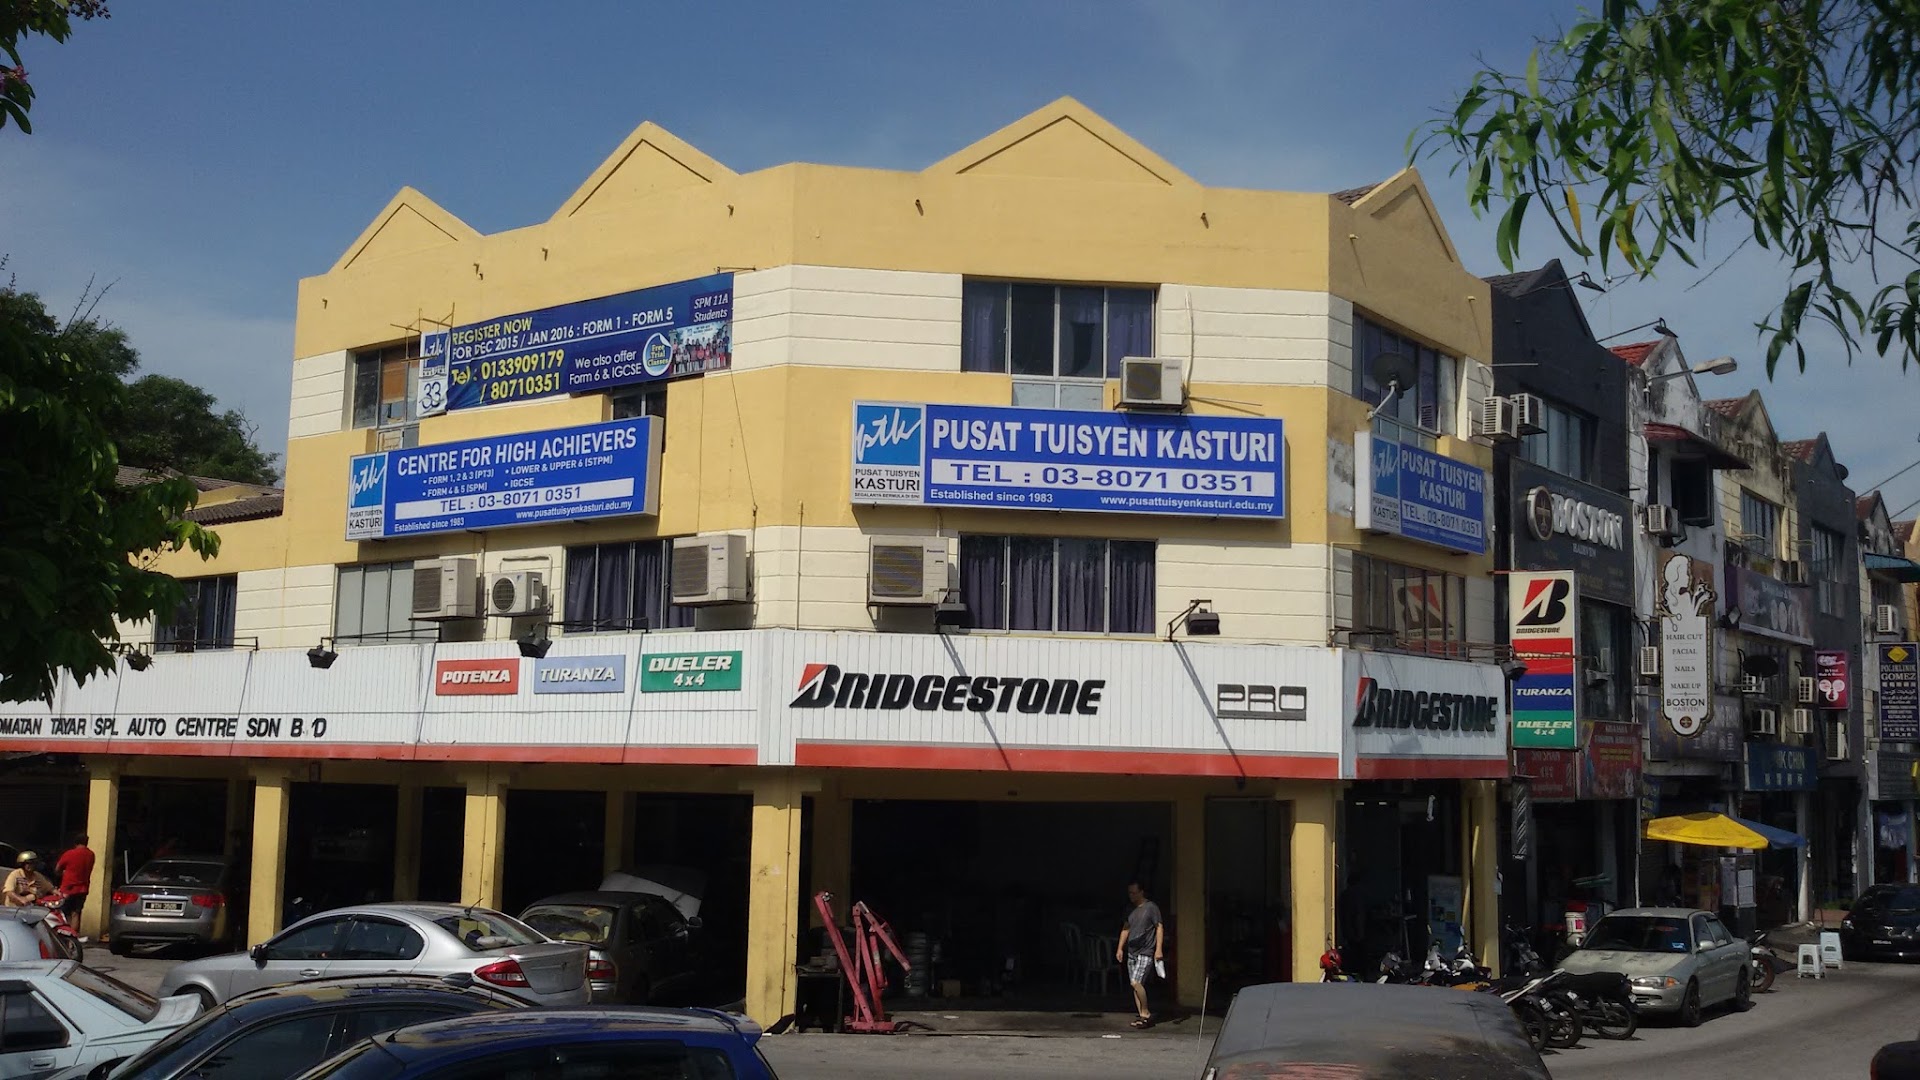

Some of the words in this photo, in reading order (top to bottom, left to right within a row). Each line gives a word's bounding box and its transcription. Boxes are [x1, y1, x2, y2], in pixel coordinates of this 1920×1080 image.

[694, 295, 712, 310] SPM
[713, 293, 729, 306] 11A
[693, 308, 728, 323] Students
[452, 323, 500, 345] REGISTER
[504, 317, 532, 335] NOW
[452, 346, 472, 360] FOR
[474, 341, 493, 356] DEC
[495, 336, 518, 352] 2015
[520, 334, 526, 348] /
[528, 330, 548, 345] JAN
[550, 326, 574, 342] 2016
[583, 318, 613, 335] FORM
[616, 317, 621, 330] 1
[632, 309, 664, 327] FORM
[666, 306, 674, 321] 5
[650, 351, 666, 359] Trial
[651, 344, 665, 352] Free
[481, 349, 564, 380] 0133909179
[575, 358, 591, 369] We
[592, 352, 611, 366] also
[614, 350, 637, 363] offer
[647, 358, 669, 367] Classes
[569, 372, 592, 385] Form
[594, 369, 600, 381] 6
[602, 367, 610, 379] &
[612, 362, 642, 378] IGCSE
[491, 372, 560, 400] 80710351
[932, 418, 1022, 452] PUSAT
[1030, 423, 1148, 458] TUISYEN
[1156, 428, 1275, 462] KASTURI
[397, 450, 458, 476] CENTRE
[461, 445, 491, 468] FOR
[495, 440, 536, 464] HIGH
[539, 427, 637, 460] ACHIEVERS
[511, 463, 540, 475] LOWER
[541, 462, 548, 472] &
[549, 459, 577, 471] UPPER
[578, 458, 583, 468] 6
[585, 454, 613, 468] (STPM)
[855, 468, 882, 477] PUSAT
[885, 469, 920, 478] TUISYEN
[1401, 449, 1437, 478] PUSAT
[1439, 461, 1482, 493] TUISYEN
[428, 474, 448, 485] FORM
[456, 472, 462, 482] 2
[462, 471, 468, 481] &
[468, 471, 474, 480] 3
[474, 468, 495, 480] (PT3)
[510, 477, 535, 488] IGCSE
[854, 477, 920, 491] KASTURI
[950, 463, 1012, 483] TEL
[1042, 467, 1168, 489] 03-8071
[1182, 473, 1253, 492] 0351
[427, 486, 448, 498] FORM
[448, 486, 453, 496] 4
[454, 485, 460, 494] &
[460, 485, 466, 494] 5
[466, 482, 488, 494] (SPM)
[930, 488, 993, 501] Established
[996, 491, 1025, 502] since
[1028, 493, 1053, 503] 1983
[1420, 480, 1466, 511] KASTURI
[440, 498, 466, 513] TEL
[478, 489, 539, 509] 03-8071
[545, 486, 581, 502] 0351
[1100, 496, 1274, 512] www.pusattuisyenkasturi.edu.my
[349, 510, 364, 518] PUSAT
[365, 508, 383, 516] TUISYEN
[516, 500, 633, 520] www.pusattuisyenkasturi.edu.my
[1373, 505, 1399, 521] KASTURI
[349, 517, 383, 529] KASTURI
[394, 518, 431, 533] Established
[432, 519, 449, 529] since
[450, 516, 465, 528] 1983
[1404, 503, 1420, 520] TEL
[1462, 519, 1480, 535] 0351
[1551, 493, 1623, 551] BOSTON
[1516, 626, 1561, 634] BRIDGESTONE
[648, 655, 732, 672] DUELER
[441, 669, 511, 685] POTENZA
[540, 666, 616, 683] TURANZA
[673, 673, 705, 687] 4x4
[1881, 672, 1916, 680] GOMEZ
[788, 663, 1105, 716] BRIDGESTONE
[1516, 688, 1572, 696] TURANZA
[1216, 684, 1308, 718] PRO
[1352, 677, 1498, 732] BRIDGESTONE
[1666, 698, 1705, 707] BOSTON
[51, 718, 87, 736] TAYAR
[94, 717, 119, 736] SPL
[127, 717, 167, 737] AUTO
[175, 717, 238, 737] CENTRE
[246, 718, 281, 738] SDN
[1516, 720, 1572, 729] DUELER
[1534, 728, 1555, 736] 4x4
